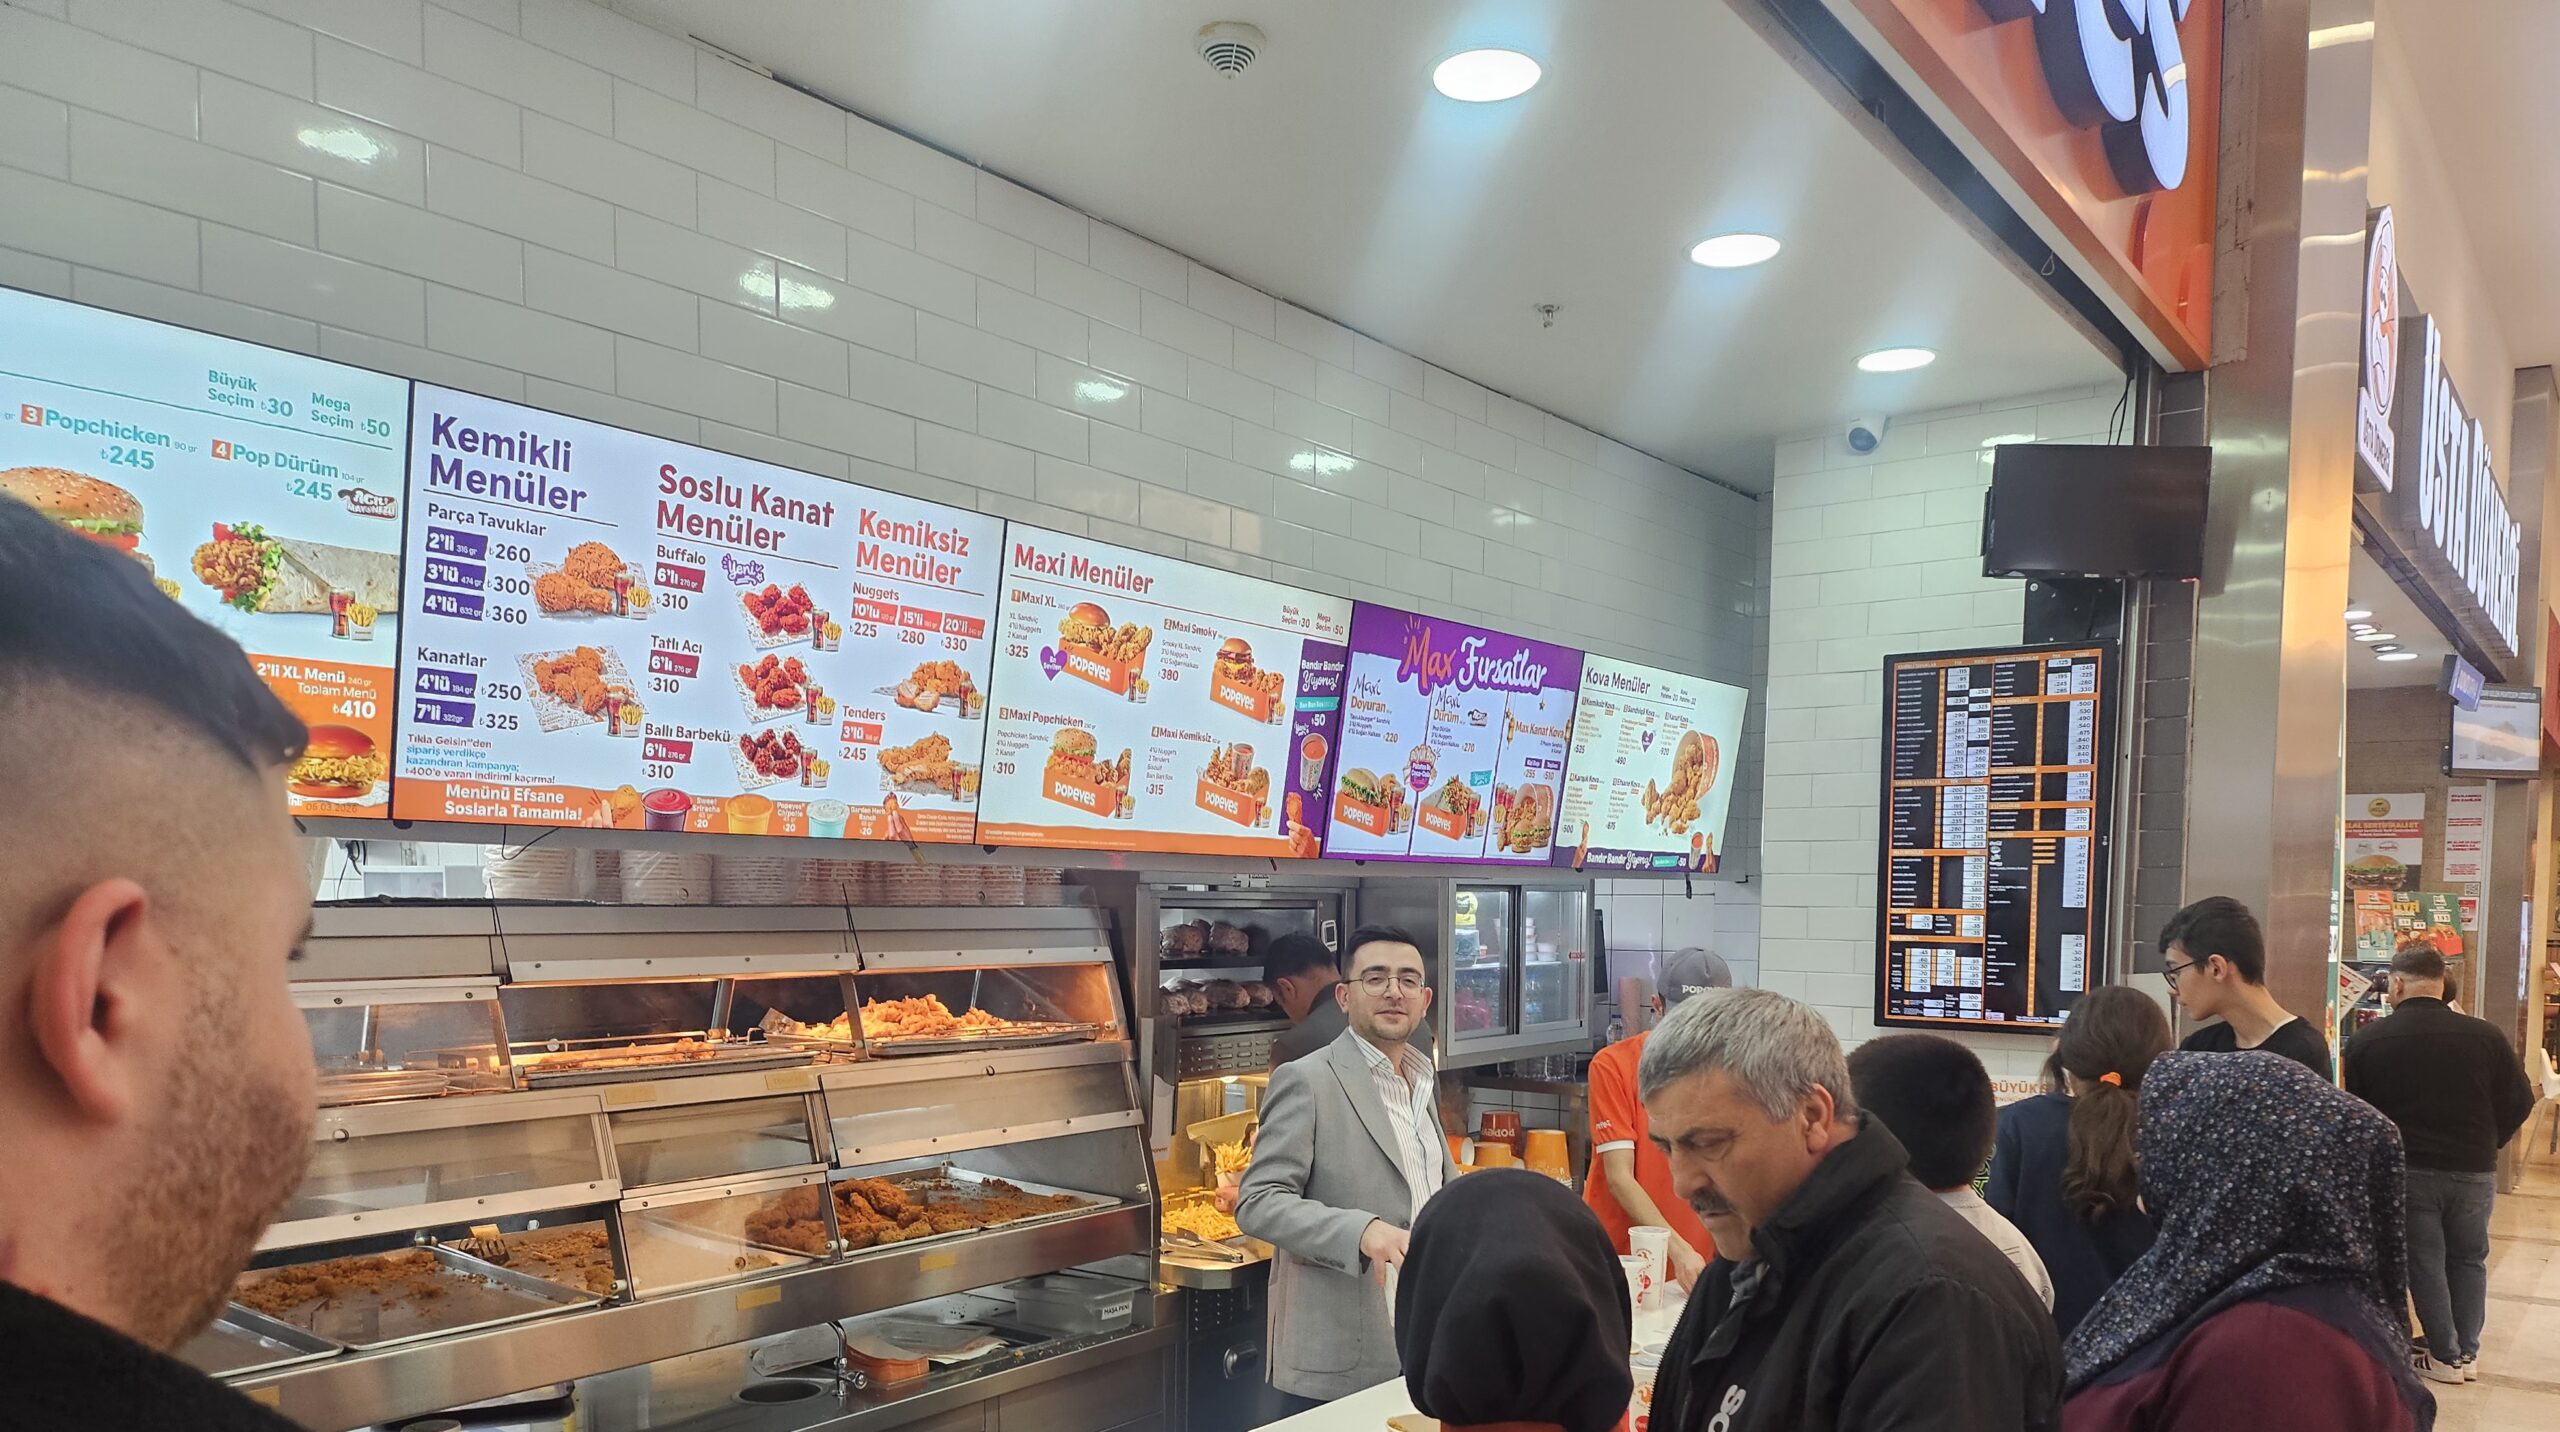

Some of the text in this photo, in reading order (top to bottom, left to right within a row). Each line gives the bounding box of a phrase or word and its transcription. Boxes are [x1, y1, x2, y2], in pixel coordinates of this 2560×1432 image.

[209, 370, 257, 391] Büyük
[208, 388, 254, 408] Seçim
[312, 393, 350, 411] Mega
[26, 407, 38, 422] 3
[46, 410, 170, 447] Popchicken
[175, 442, 186, 450] 90
[311, 410, 353, 429] Seçim
[432, 412, 572, 472] Kemikli
[2420, 313, 2469, 579] USTA
[216, 443, 226, 457] 4
[234, 444, 269, 467] Pop
[275, 452, 338, 477] Dürüm
[430, 453, 587, 513] Menüler
[658, 464, 834, 527] Soslu Kanat
[428, 503, 546, 536] Parça Tavuklar
[657, 500, 786, 551] Menüler
[859, 508, 969, 556] Kemiksiz
[428, 533, 454, 551] 2'li
[657, 545, 706, 565] Buffalo
[857, 541, 961, 585] Menüler
[427, 563, 459, 581] 3'lü
[1015, 544, 1153, 594] Maxi Menüler
[853, 582, 899, 600] Nuggets
[1021, 591, 1056, 608] Maxi XL
[426, 594, 457, 613] 4'lü
[1283, 605, 1299, 615] Büyük
[1172, 620, 1218, 639] Maxi Smoky
[651, 635, 702, 654] Tatlı Acı
[418, 648, 487, 667] Kanatlar
[1402, 627, 1547, 689] Max Fırsatlar
[257, 663, 279, 676] 2'li
[283, 665, 301, 678] XL
[305, 668, 345, 682] Menü
[348, 677, 362, 685] 240
[418, 673, 450, 691] 4'lü
[1586, 667, 1650, 694] Kova Menüler
[298, 682, 376, 699] Toplam Menü
[416, 703, 441, 719] 7'li
[843, 706, 886, 720] Tenders
[1351, 696, 1386, 712] Doyuran
[1009, 709, 1083, 727] Maxi Popchicken
[1434, 709, 1459, 724] Dürüm
[408, 734, 432, 744] Tıkla
[645, 723, 731, 742] Ballı Barbekü
[1160, 728, 1211, 743] Maxi Kemiksiz
[1515, 721, 1564, 738] Max Kanat Kova
[406, 746, 486, 758] sipariş verdikçe
[406, 756, 519, 772] kazandıran kampanya;
[444, 769, 471, 778] varan
[515, 773, 555, 783] kaçırma!
[446, 784, 564, 803] Menünü Efsane
[445, 801, 582, 821] Soslarla Tamamla!
